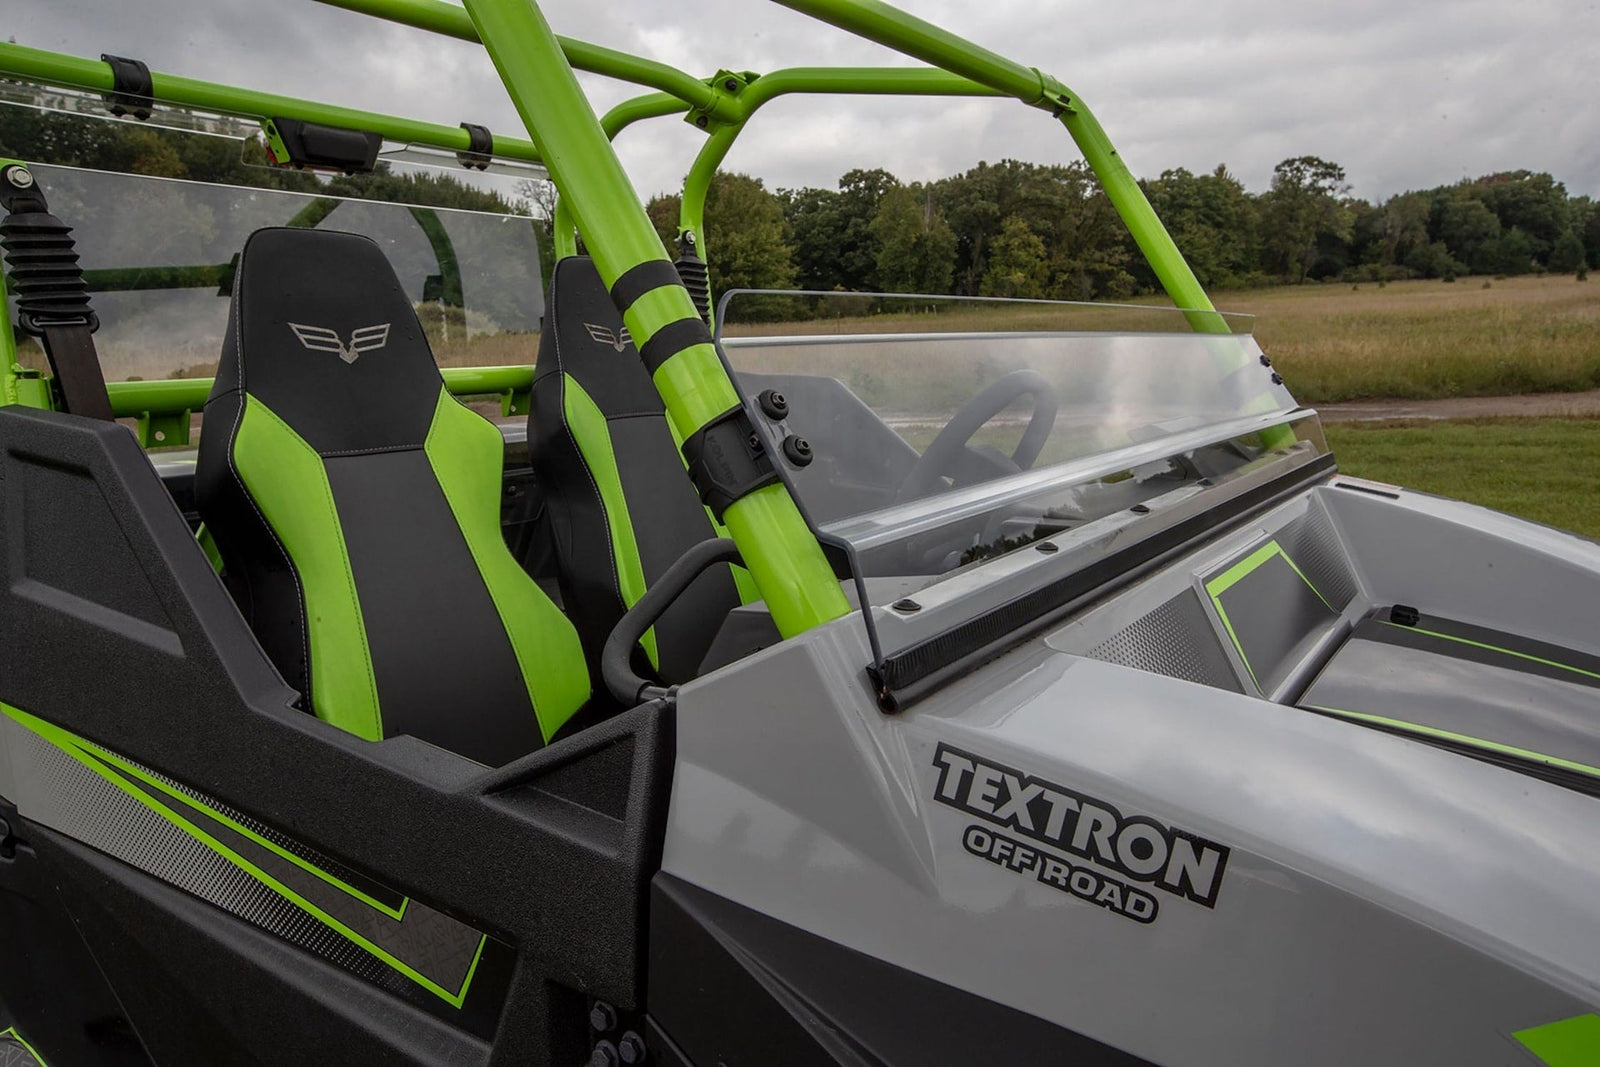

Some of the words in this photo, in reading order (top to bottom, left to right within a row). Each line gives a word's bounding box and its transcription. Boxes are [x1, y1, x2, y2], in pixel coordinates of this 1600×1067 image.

[935, 744, 1228, 906] TEXTRON
[963, 826, 1038, 872] OFF
[1039, 856, 1157, 922] ROAD
